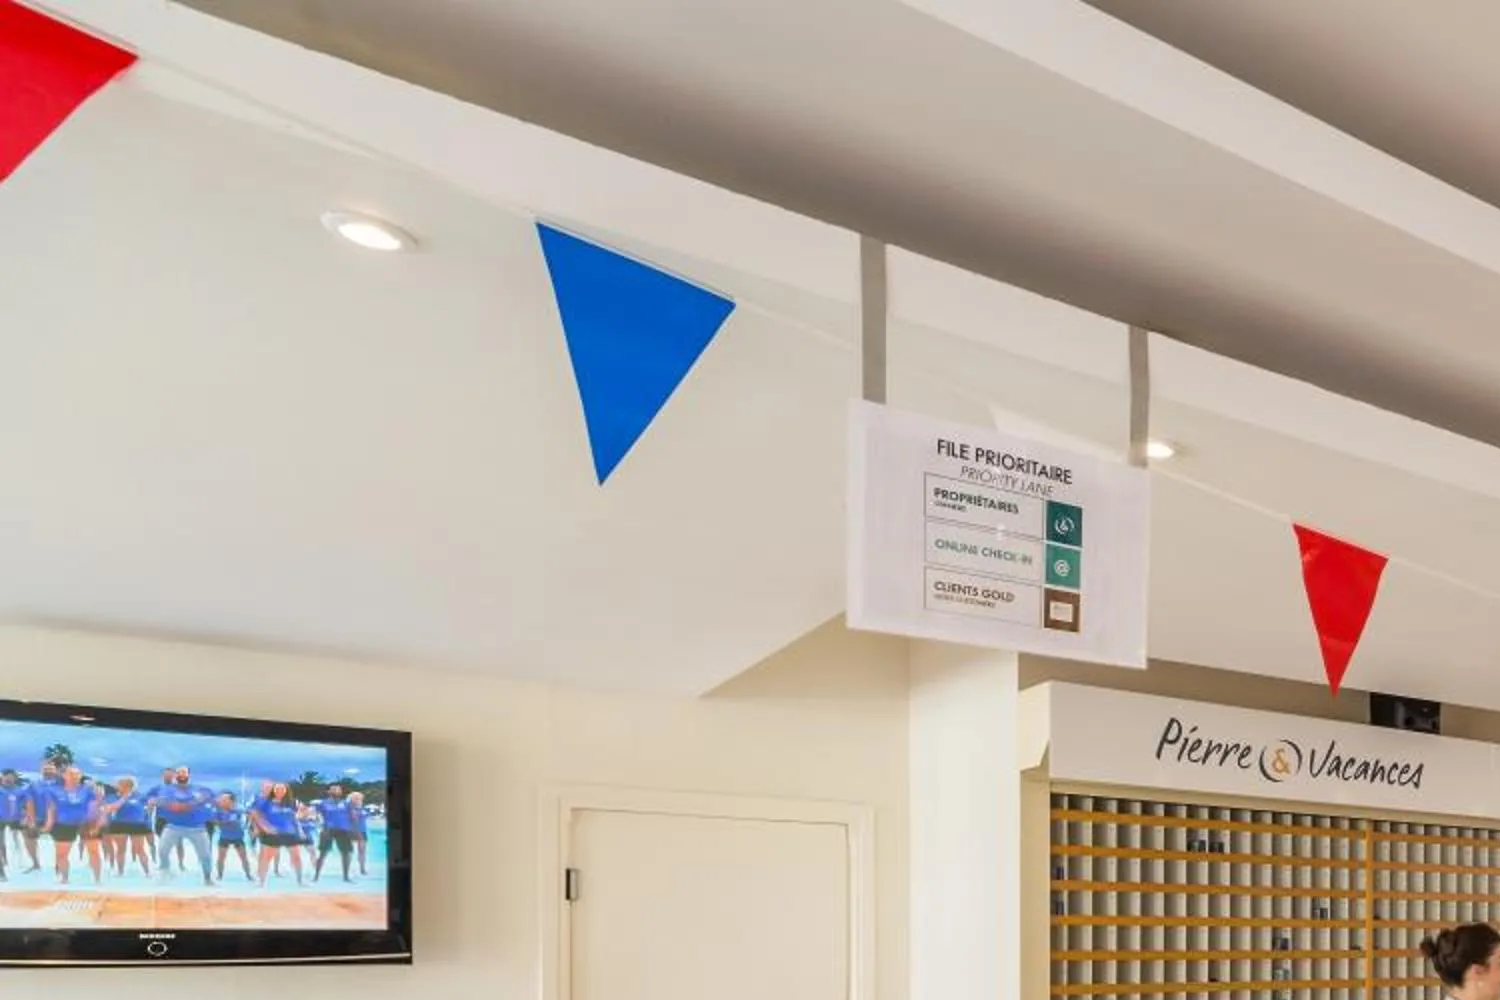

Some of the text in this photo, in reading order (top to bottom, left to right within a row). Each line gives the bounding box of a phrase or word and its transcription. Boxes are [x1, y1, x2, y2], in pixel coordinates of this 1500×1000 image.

[937, 438, 1073, 485] FILE PRIORITAIRE
[933, 581, 979, 597] CLIENTS
[981, 588, 1016, 603] GOLD
[1309, 740, 1425, 790] Vacances
